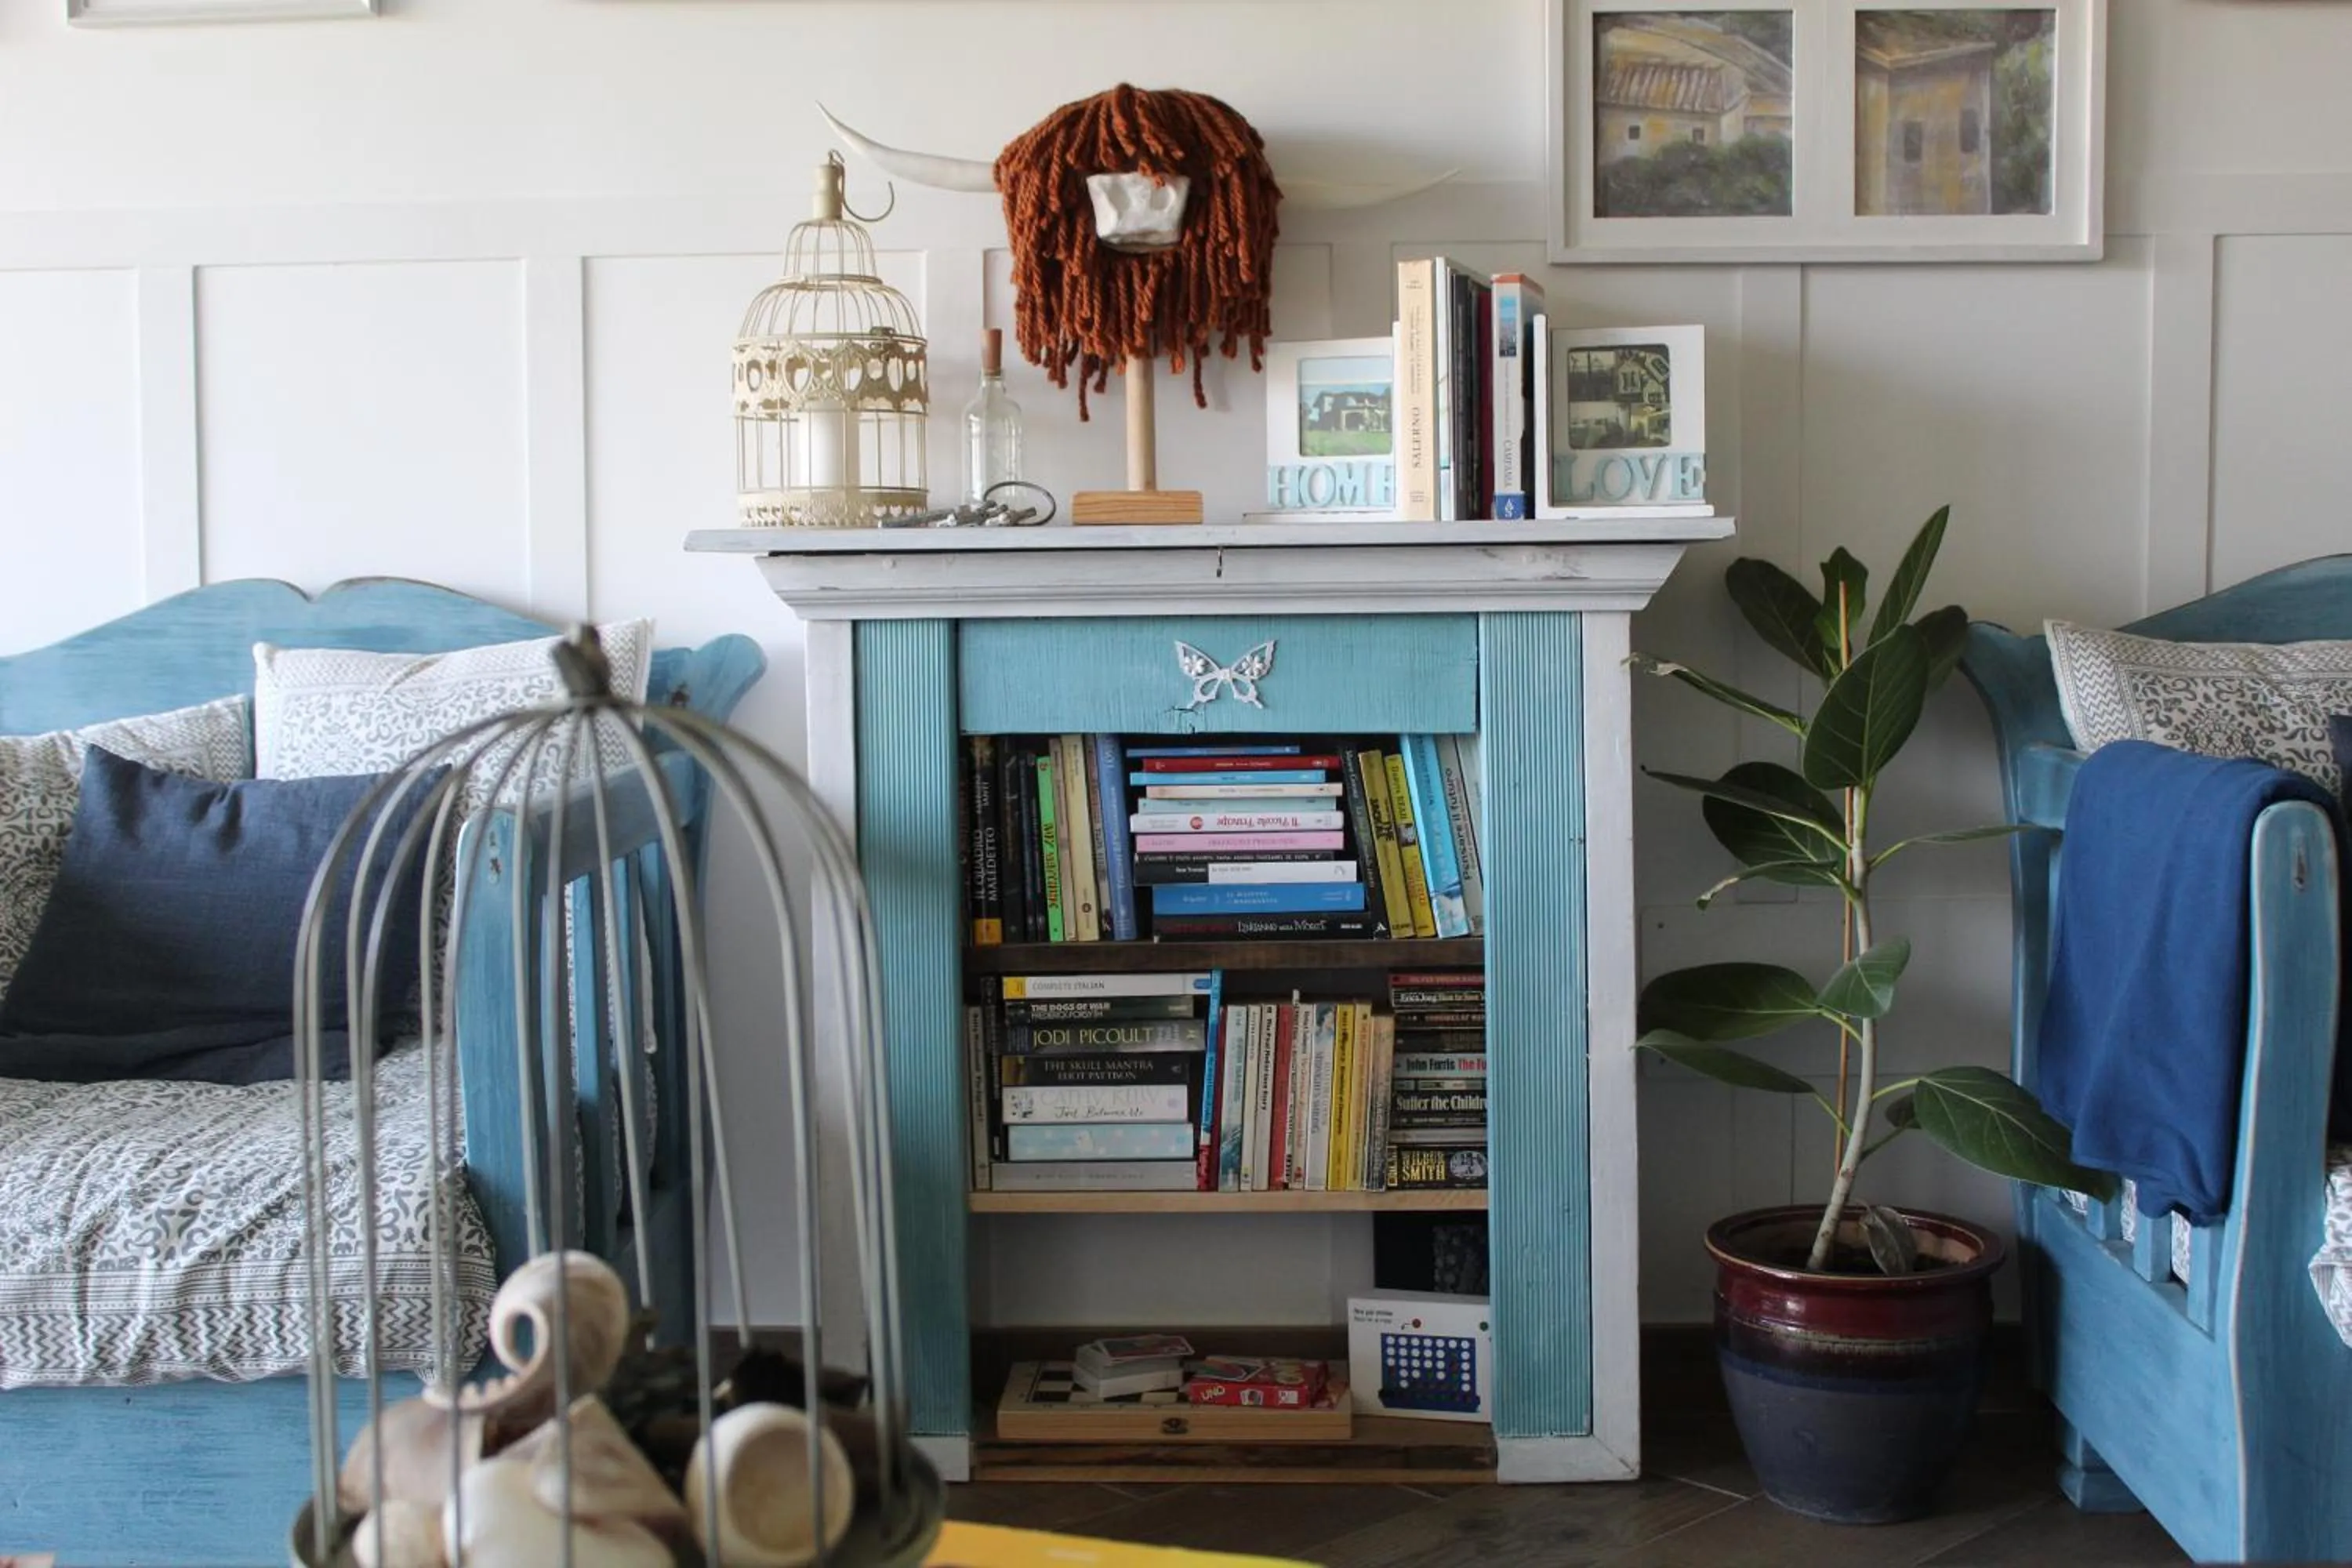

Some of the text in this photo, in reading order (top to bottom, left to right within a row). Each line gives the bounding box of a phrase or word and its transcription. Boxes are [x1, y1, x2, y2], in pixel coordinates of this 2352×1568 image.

[1411, 406, 1422, 469] SALERNO
[1554, 452, 1704, 504] LOVE
[1444, 768, 1459, 810] futuro
[1217, 815, 1299, 827] Il Piccolo Principe
[1449, 810, 1461, 821] il
[1452, 823, 1472, 881] Pensare
[1032, 980, 1105, 991] COMPLETE ITALIAN
[1033, 1029, 1070, 1047] JODI
[1079, 1027, 1153, 1044] PICOULT
[1044, 1060, 1154, 1072] THE SKULL MANTRA
[1406, 1058, 1427, 1073] John
[1396, 1095, 1429, 1110] Suffer
[1431, 1095, 1450, 1110] the
[1054, 1106, 1079, 1118] Just
[1402, 1151, 1446, 1165] WILBUR
[1402, 1164, 1446, 1181] SMITH
[1200, 1385, 1226, 1401] UNO
